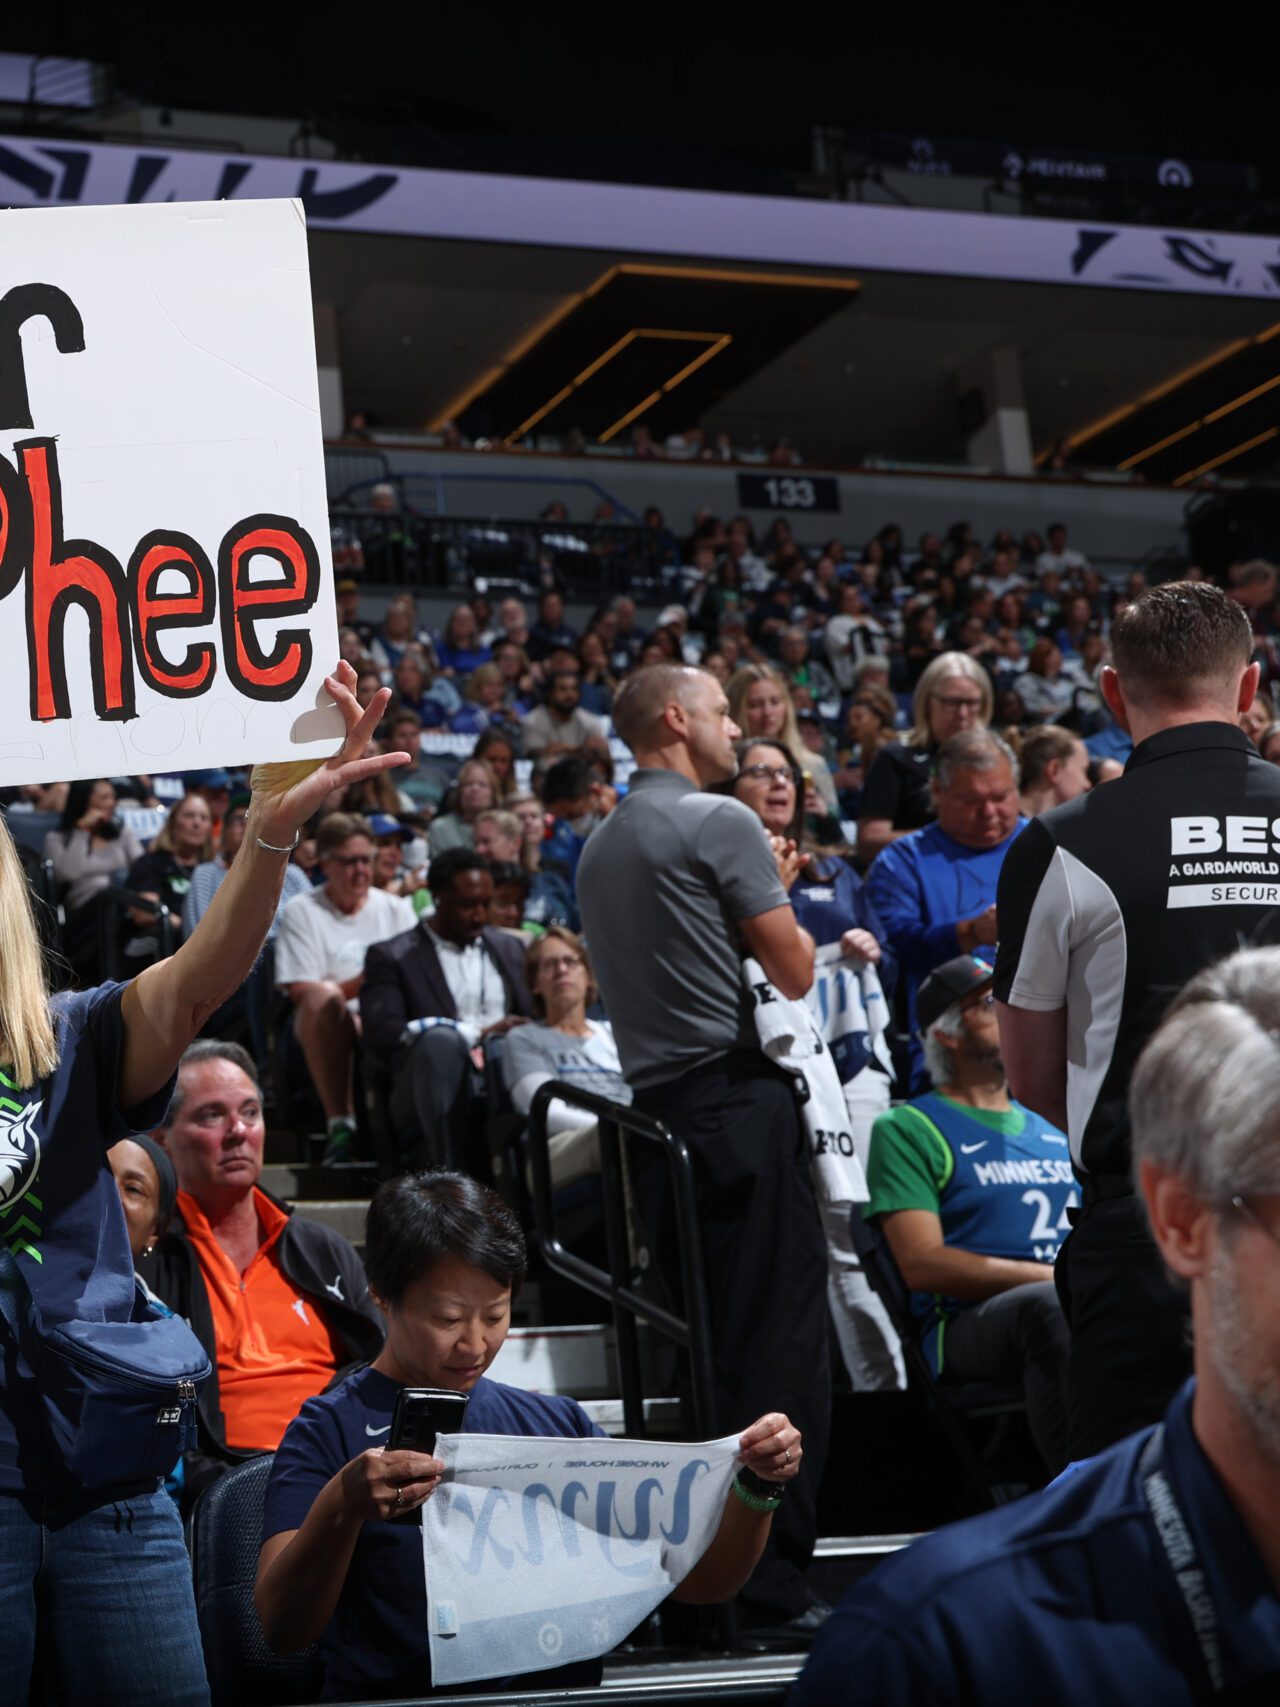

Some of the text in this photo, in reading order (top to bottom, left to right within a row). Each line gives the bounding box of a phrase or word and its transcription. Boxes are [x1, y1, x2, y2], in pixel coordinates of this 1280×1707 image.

[763, 479, 816, 507] 133
[1170, 815, 1280, 855] BE
[1169, 861, 1279, 877] A GARDAWORLD
[1211, 887, 1279, 901] SECUR
[972, 1160, 1073, 1186] MINNESO
